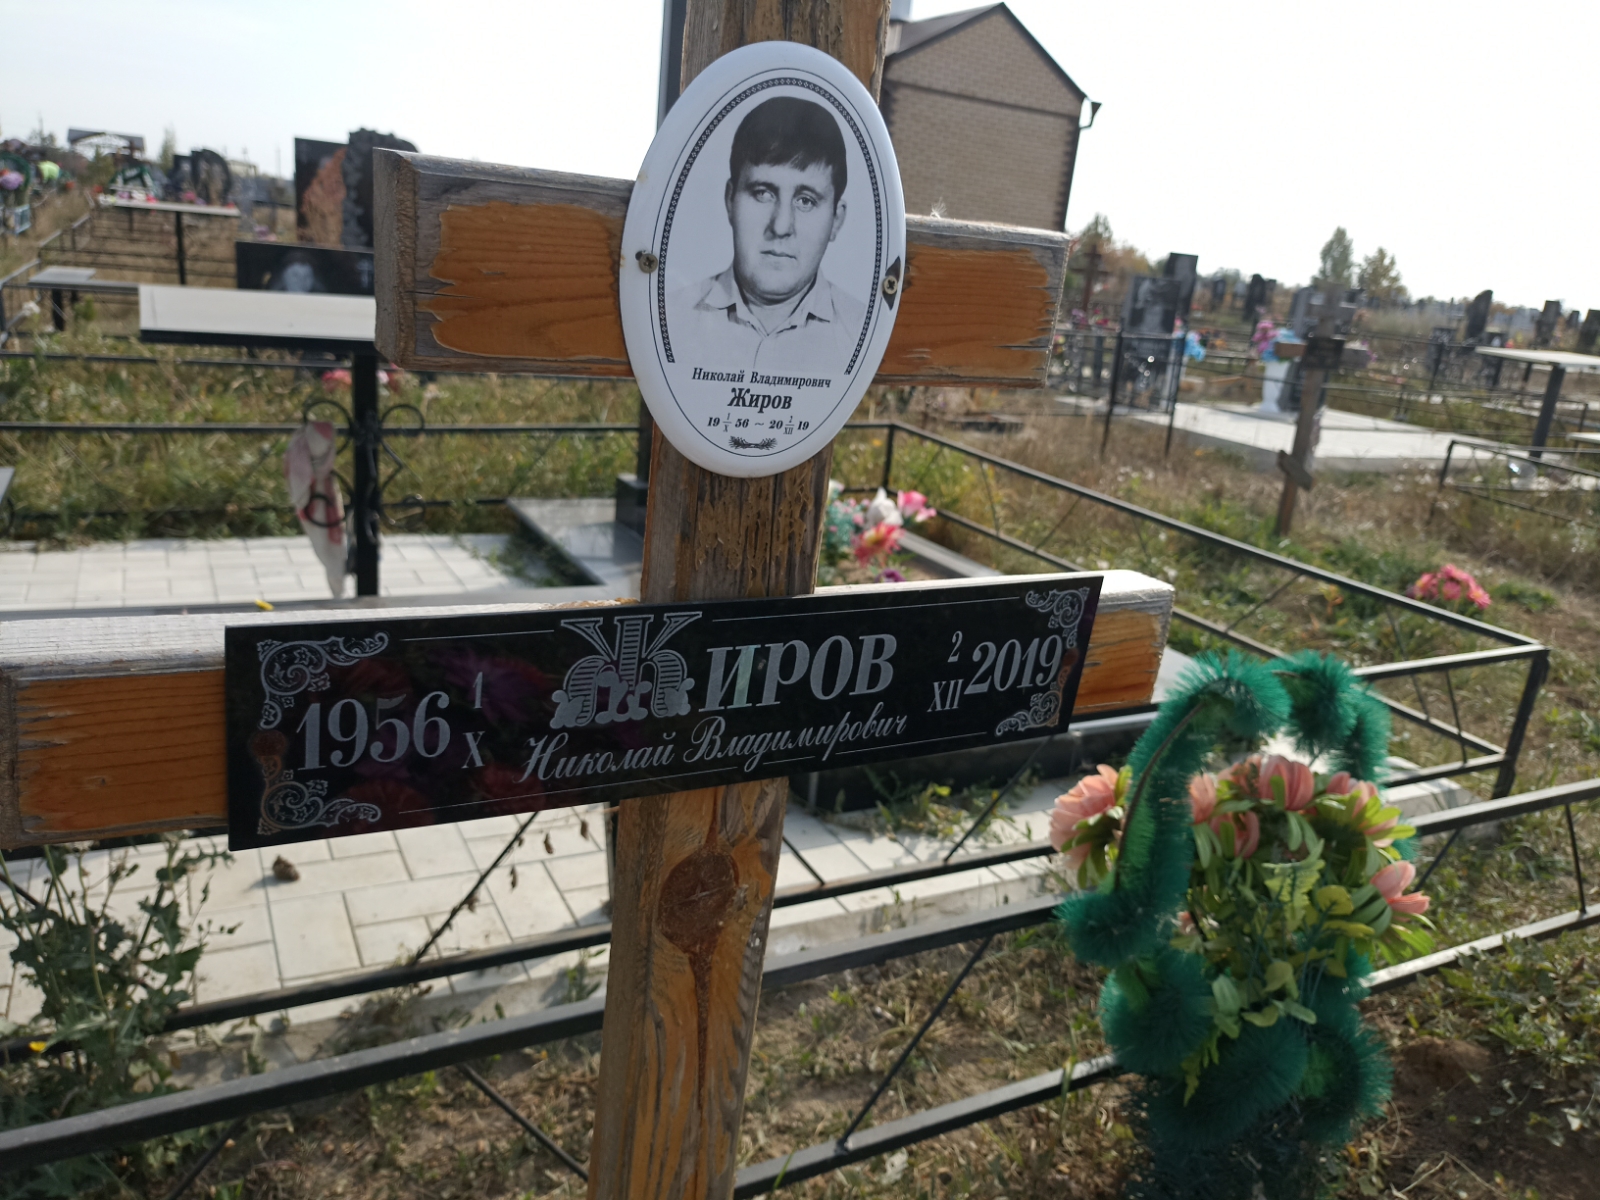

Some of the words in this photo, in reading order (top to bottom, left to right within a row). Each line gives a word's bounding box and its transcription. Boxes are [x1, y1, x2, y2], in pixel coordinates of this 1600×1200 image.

[691, 367, 745, 383] Николай
[750, 370, 832, 389] Владимирович
[727, 387, 793, 413] Жиров
[947, 630, 962, 663] 2
[963, 634, 1063, 696] 2019
[296, 692, 450, 771] 1956
[520, 732, 674, 783] Николай
[682, 701, 908, 773] Владимирович
